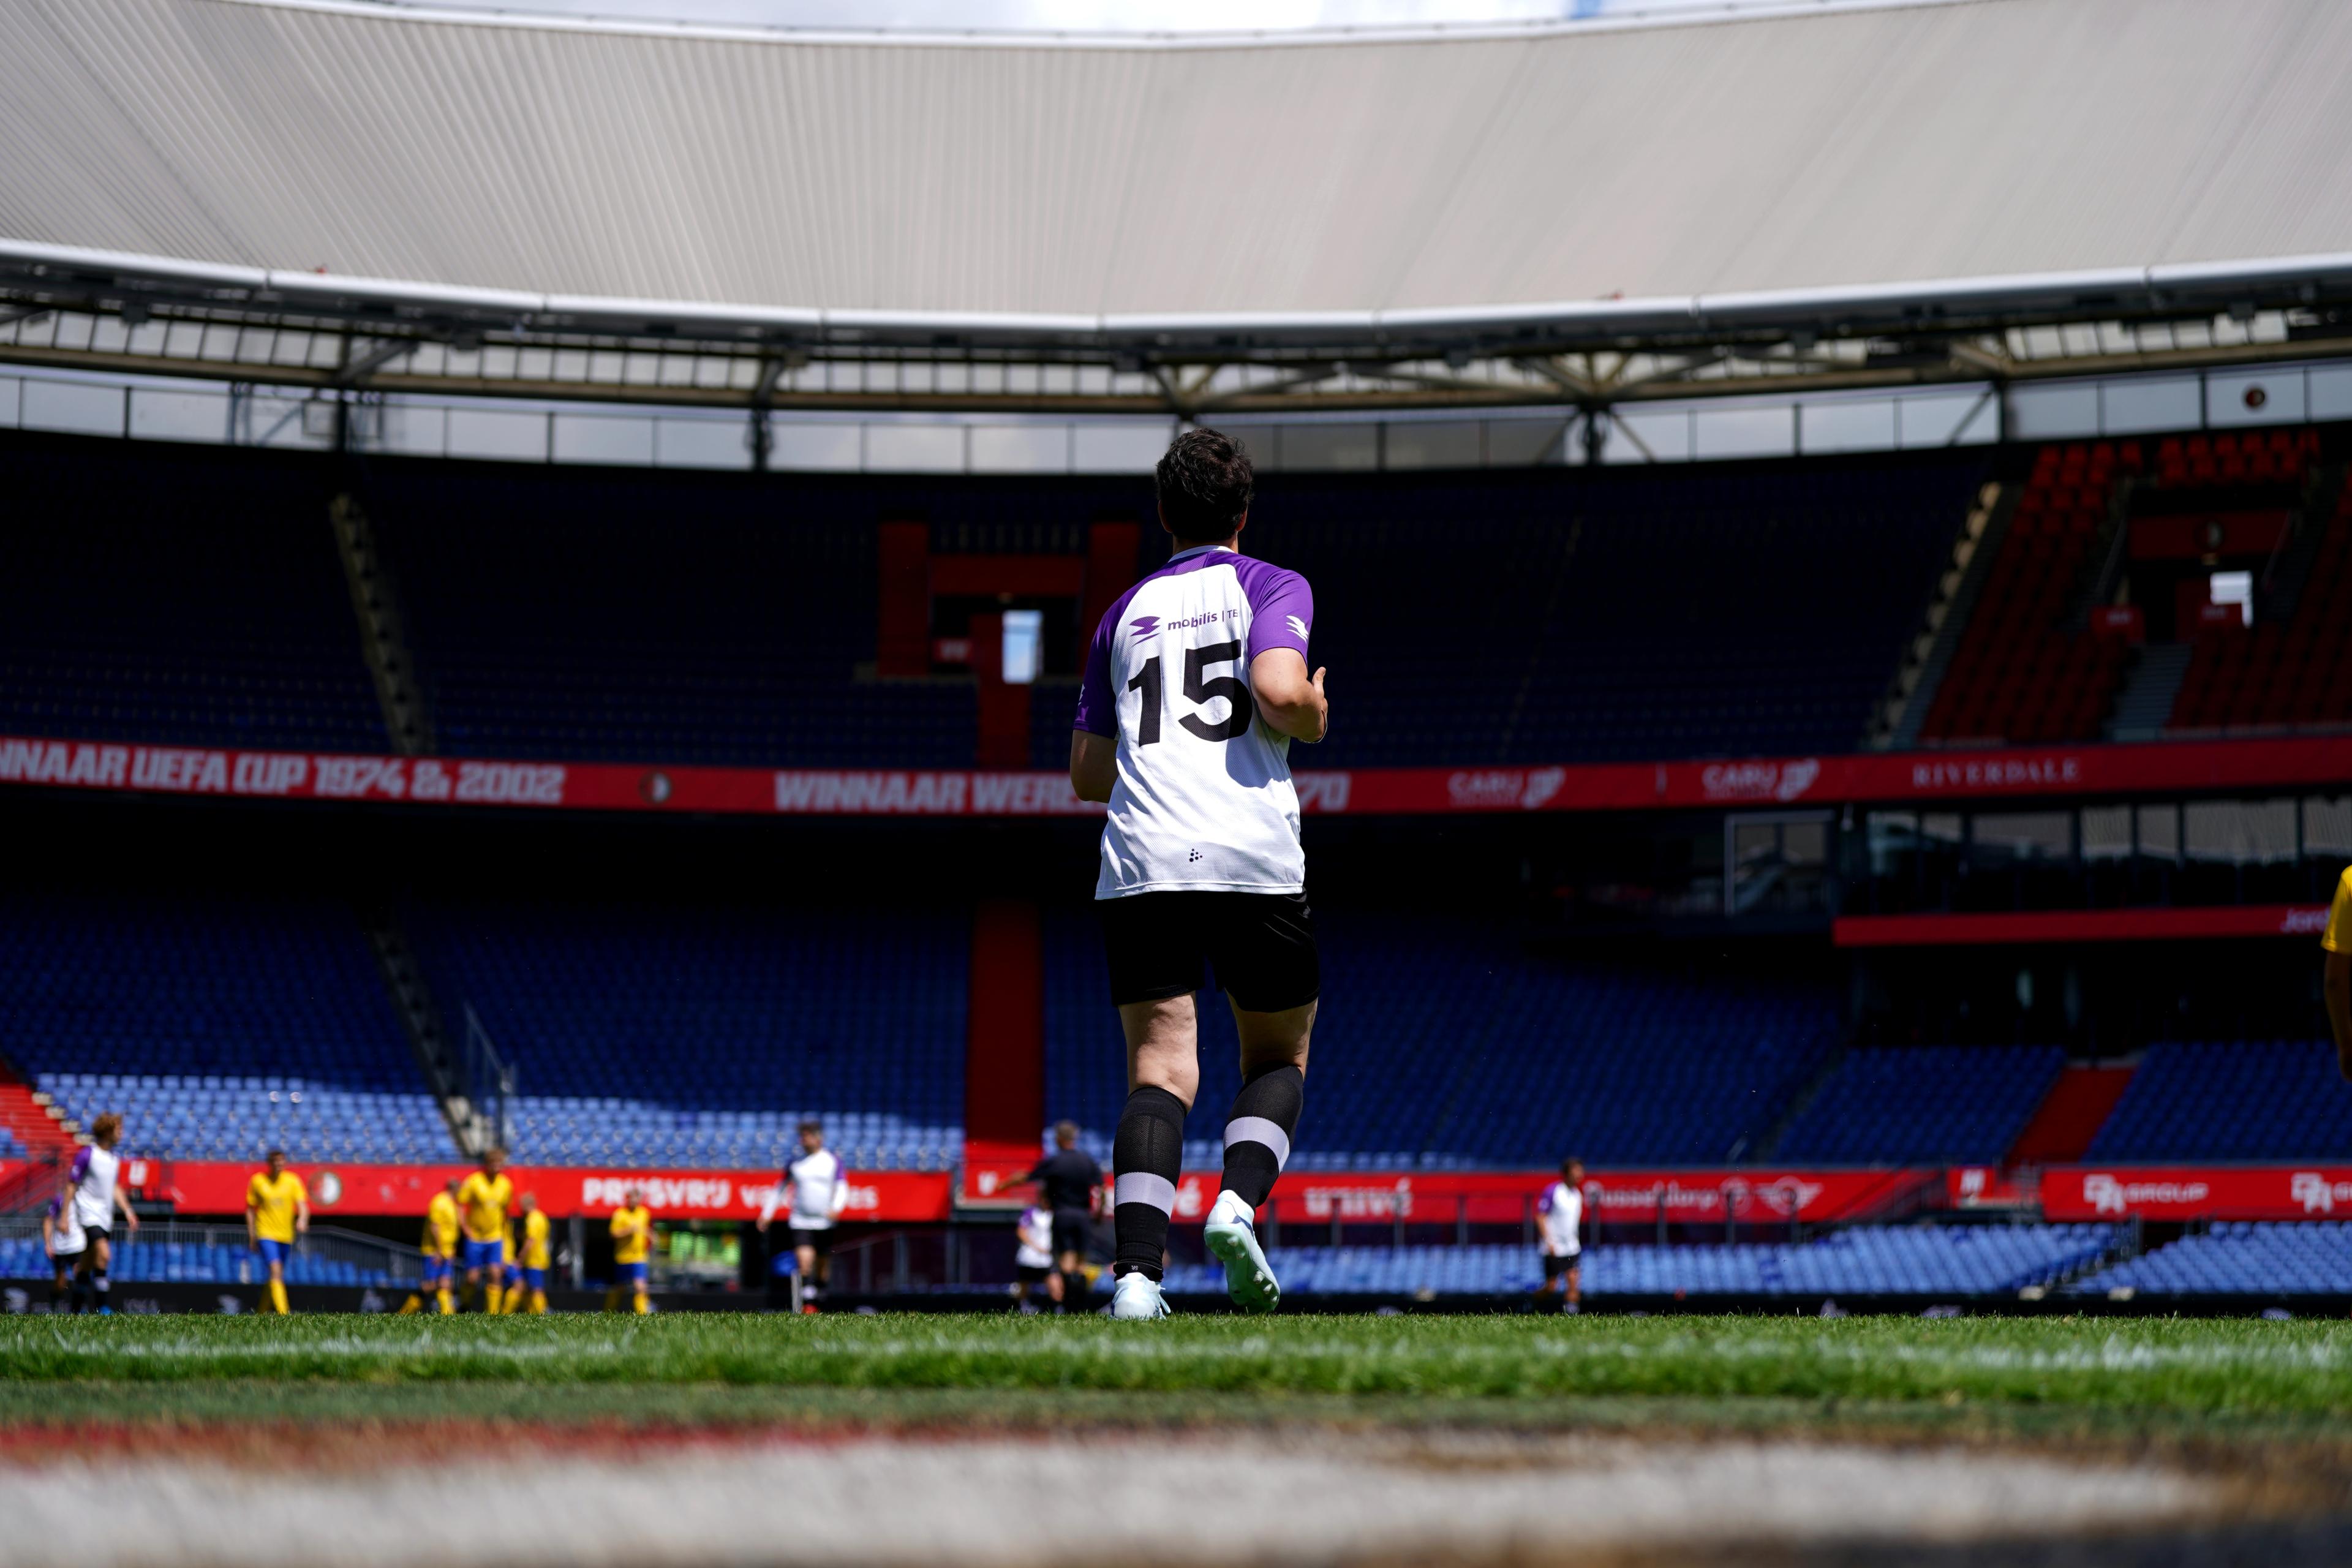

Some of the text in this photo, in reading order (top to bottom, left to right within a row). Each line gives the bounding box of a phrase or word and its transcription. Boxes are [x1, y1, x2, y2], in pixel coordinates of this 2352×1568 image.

[1167, 612, 1218, 630] mobilis
[1128, 639, 1253, 747] 15
[131, 747, 227, 793] UEFA
[233, 753, 307, 795] CUP
[314, 755, 407, 799] 1974
[410, 759, 451, 801] &
[454, 761, 566, 805] 2002
[774, 771, 970, 813] WINNAAR
[1293, 772, 1351, 812] 70
[1912, 757, 2081, 788] RIVERDALE
